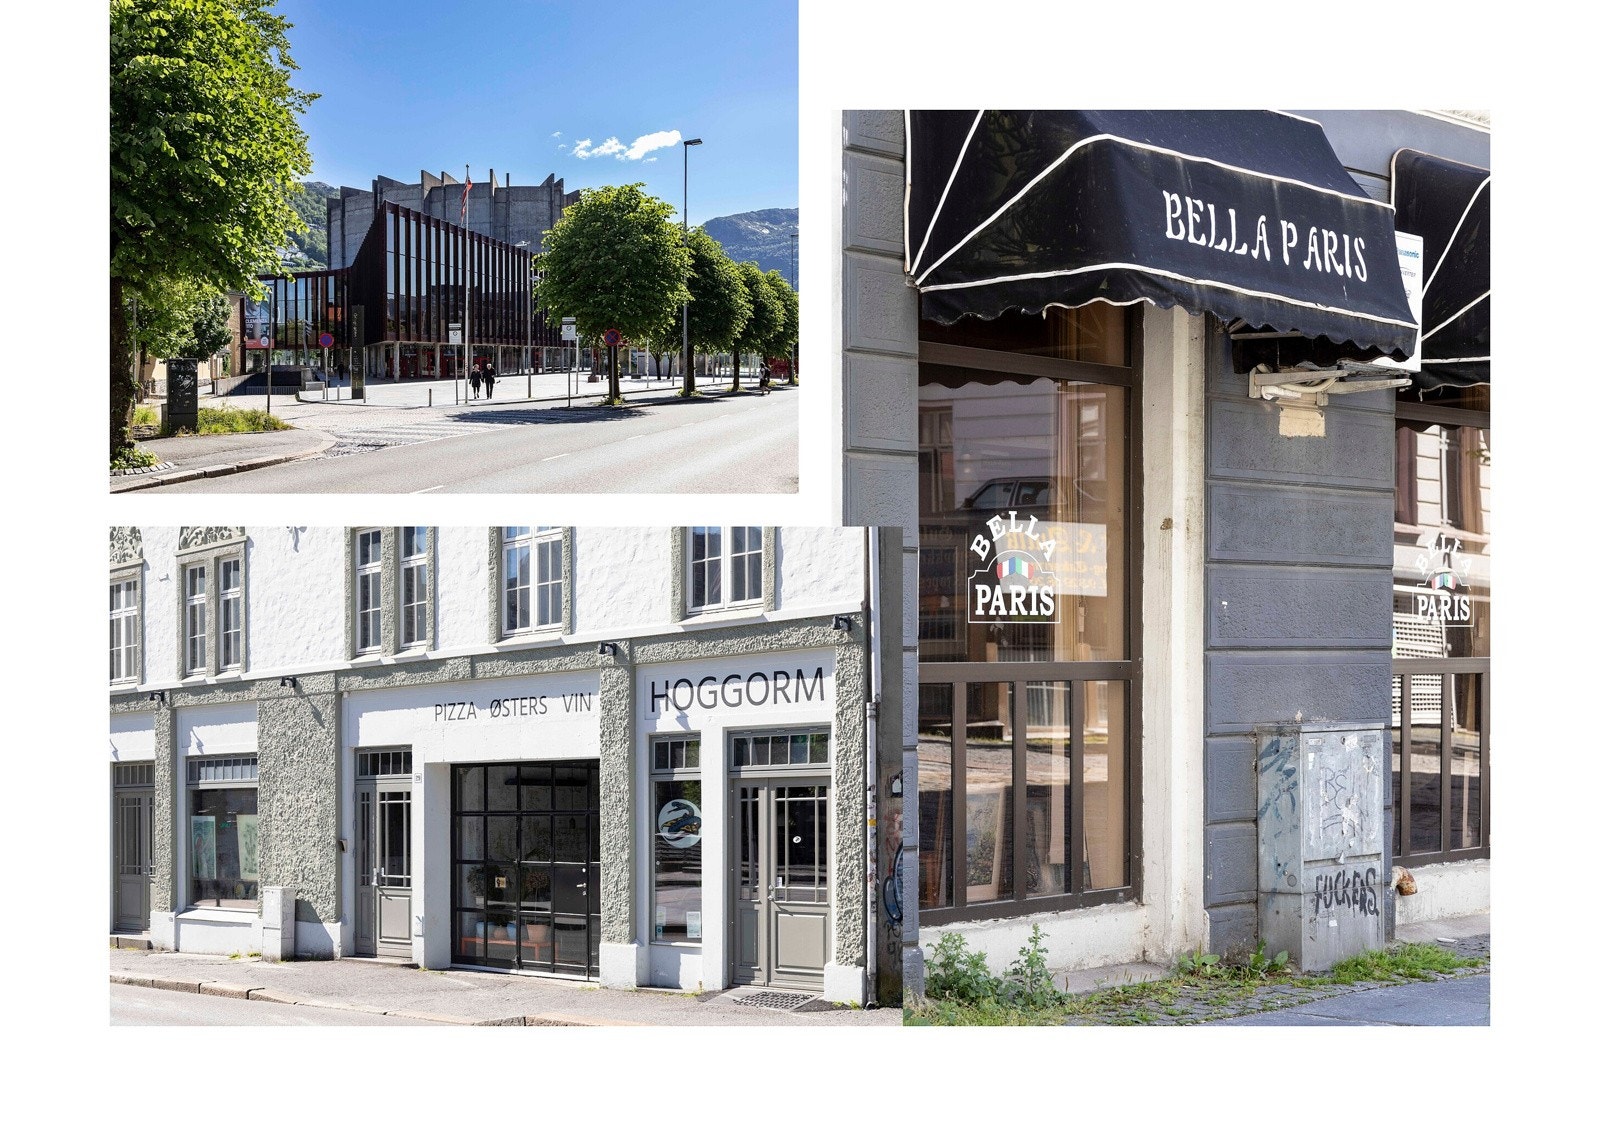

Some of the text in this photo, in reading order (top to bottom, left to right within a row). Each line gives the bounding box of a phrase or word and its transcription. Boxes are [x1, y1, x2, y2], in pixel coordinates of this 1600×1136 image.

[1163, 190, 1367, 282] BELLA PARIS
[1397, 249, 1419, 258] anasonic
[970, 511, 1056, 562] BELLA
[1415, 535, 1472, 576] BELLA
[975, 584, 1054, 617] PARIS
[1416, 595, 1470, 621] PARIS
[434, 692, 592, 722] PIZZA ØSTERS VIN
[650, 667, 824, 713] HOGGORM
